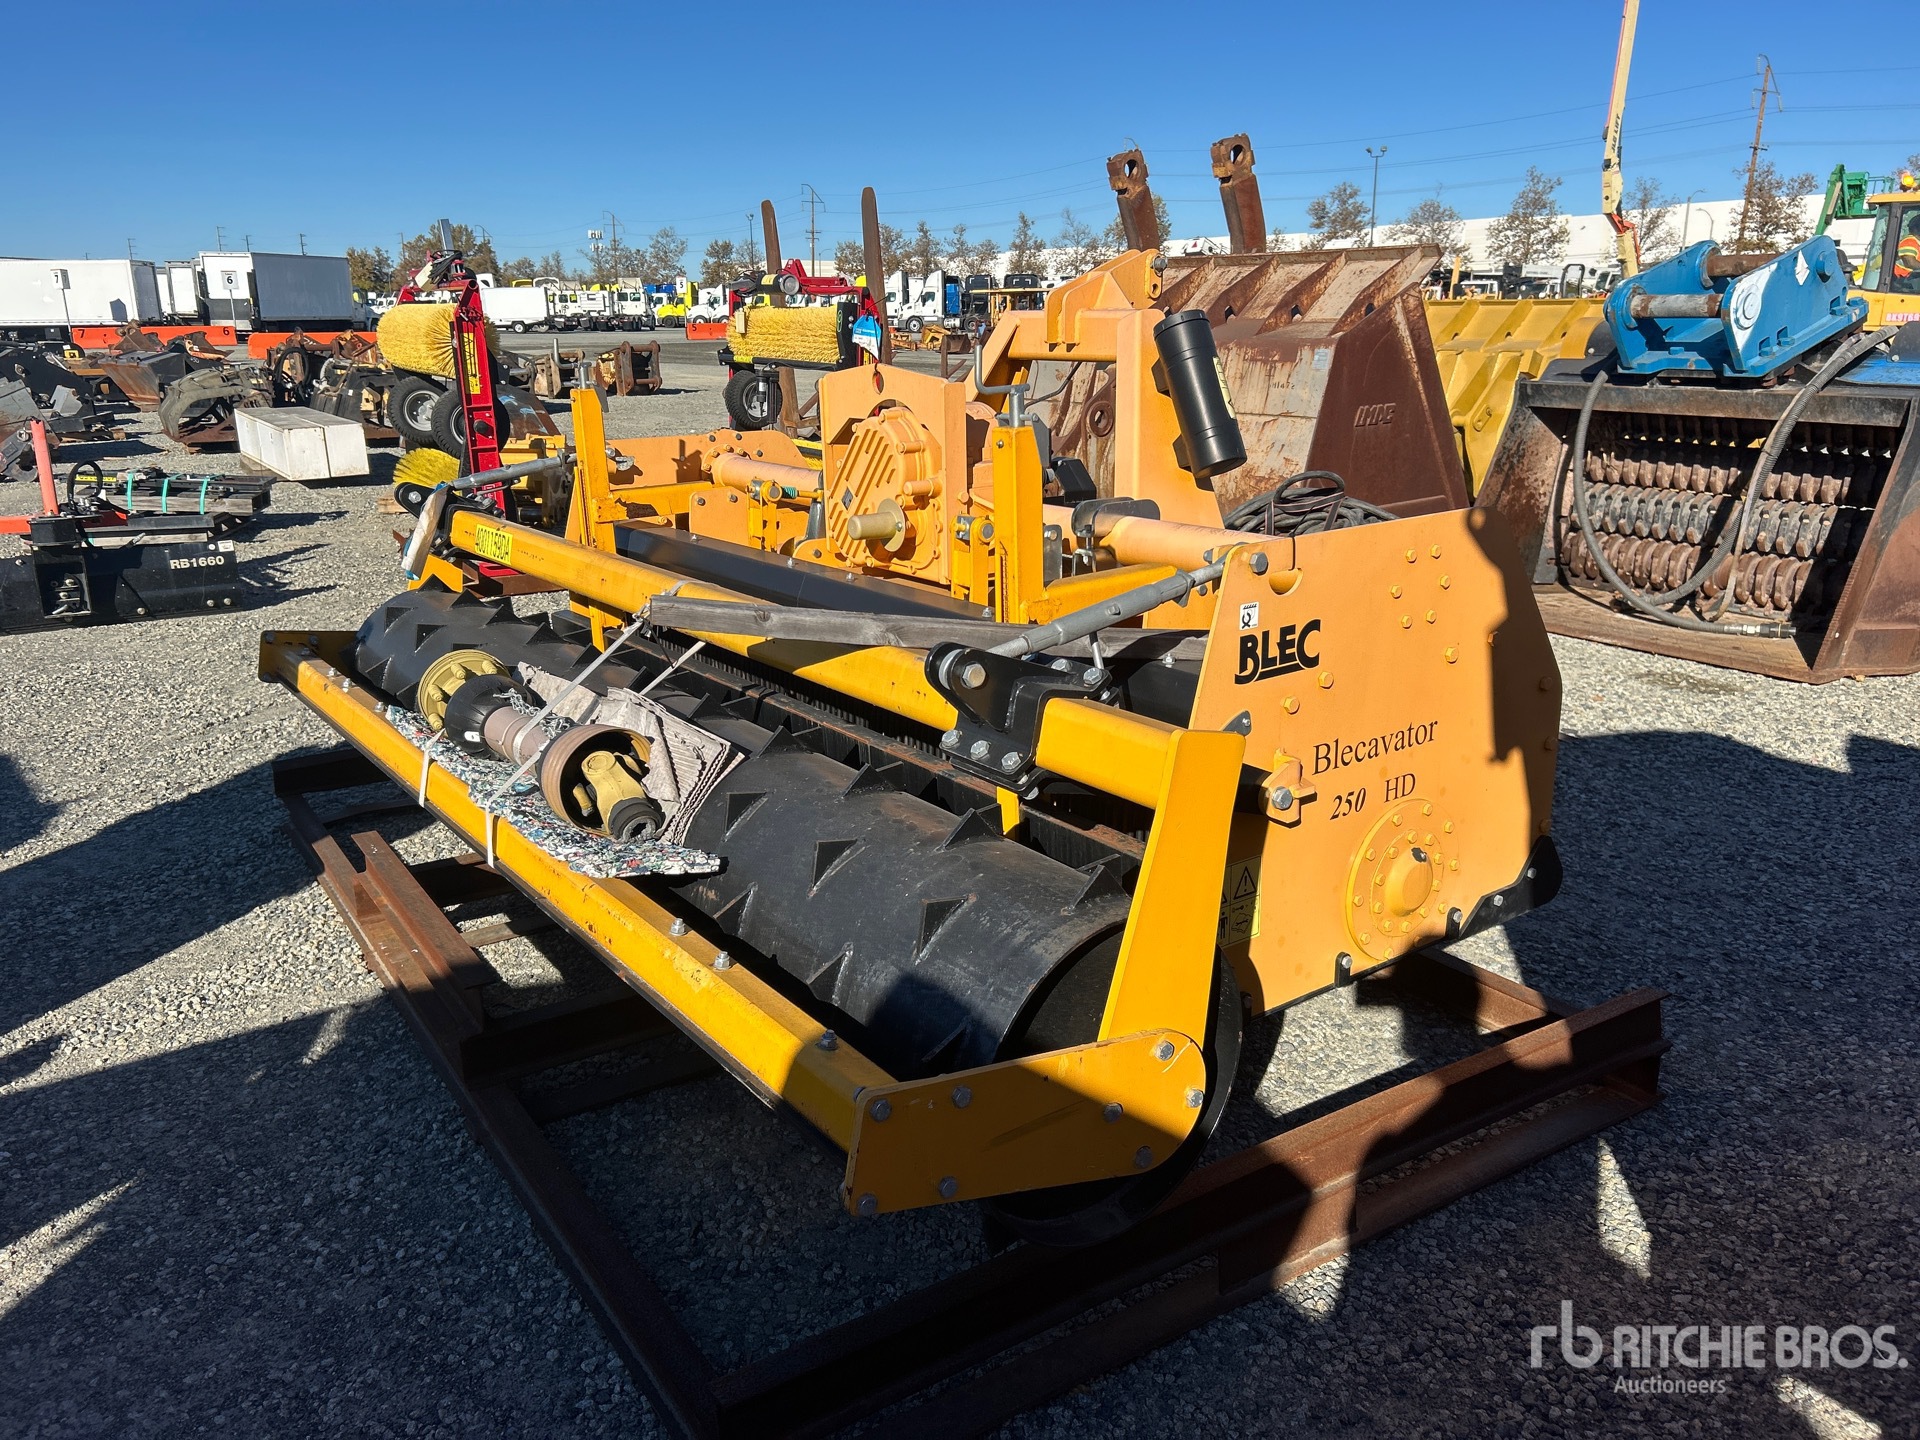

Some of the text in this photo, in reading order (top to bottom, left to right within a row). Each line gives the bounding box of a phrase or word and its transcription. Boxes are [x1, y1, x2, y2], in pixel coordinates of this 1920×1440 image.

[226, 275, 234, 285] 6
[77, 328, 86, 339] 7
[222, 326, 230, 336] 6
[692, 324, 697, 332] 5
[170, 556, 224, 569] RB1660
[1234, 618, 1321, 685] BLEC
[1311, 720, 1438, 776] Blecavator
[1329, 772, 1416, 821] 250 HD
